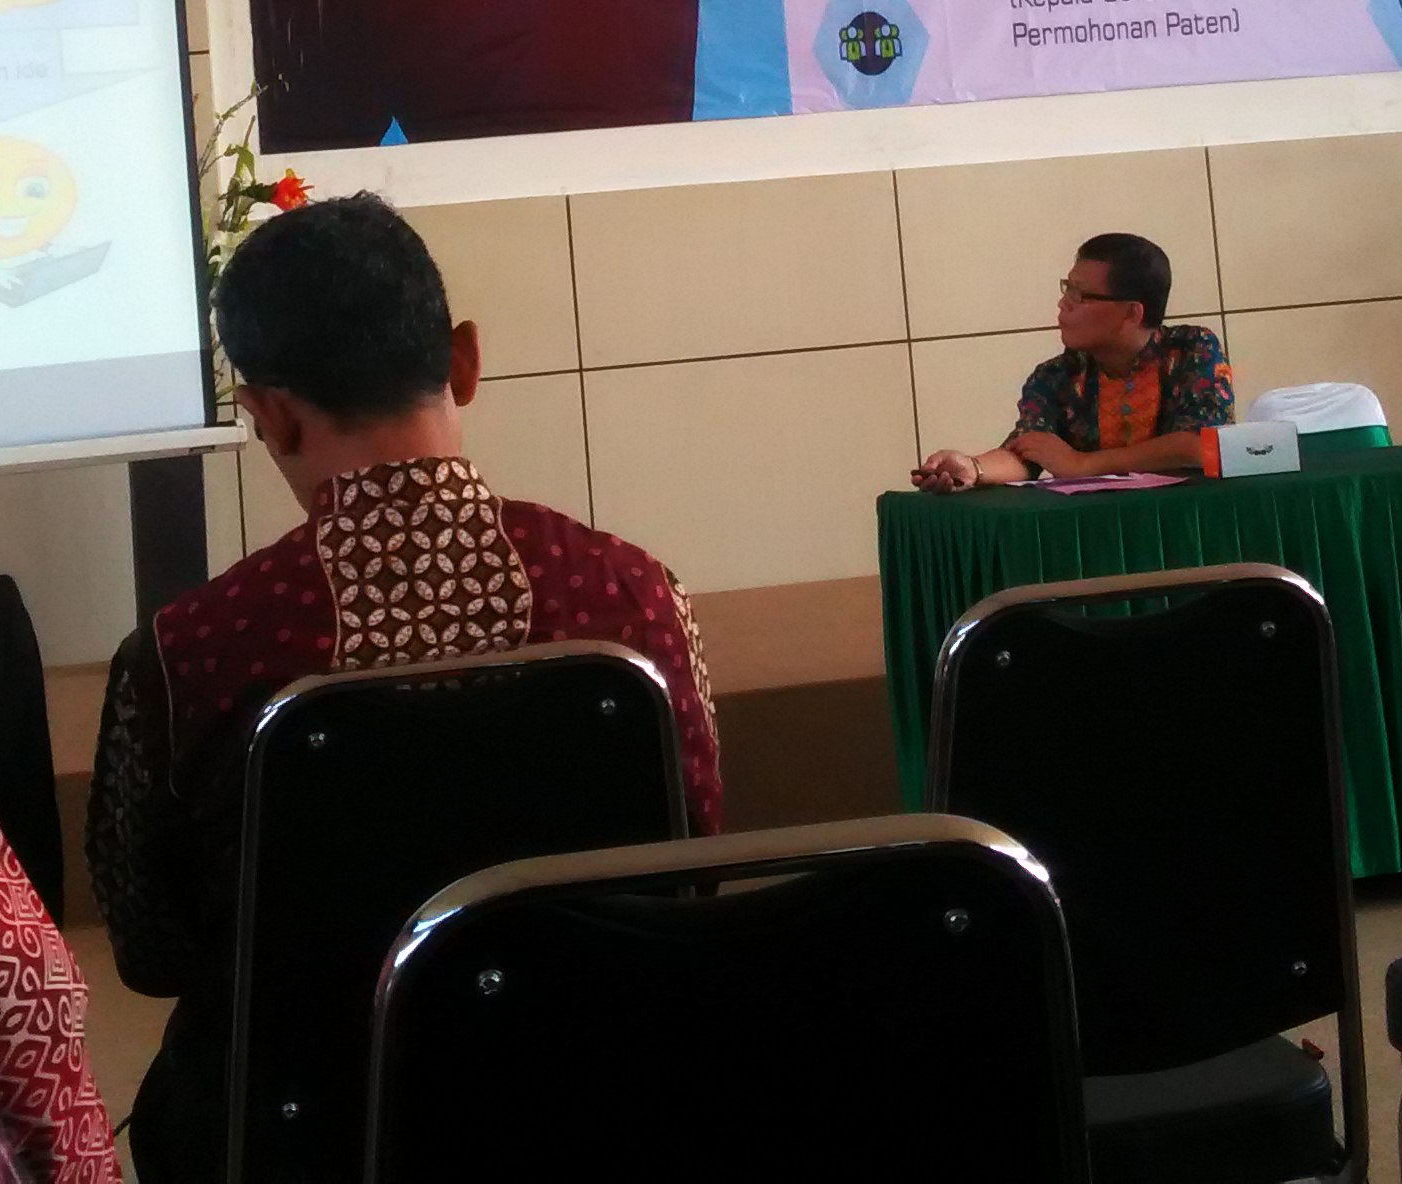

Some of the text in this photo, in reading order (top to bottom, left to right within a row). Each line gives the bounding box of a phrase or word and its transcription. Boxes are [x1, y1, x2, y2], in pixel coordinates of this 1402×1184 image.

[1012, 8, 1241, 48] Permohonan Paten)
[16, 61, 49, 79] ide
